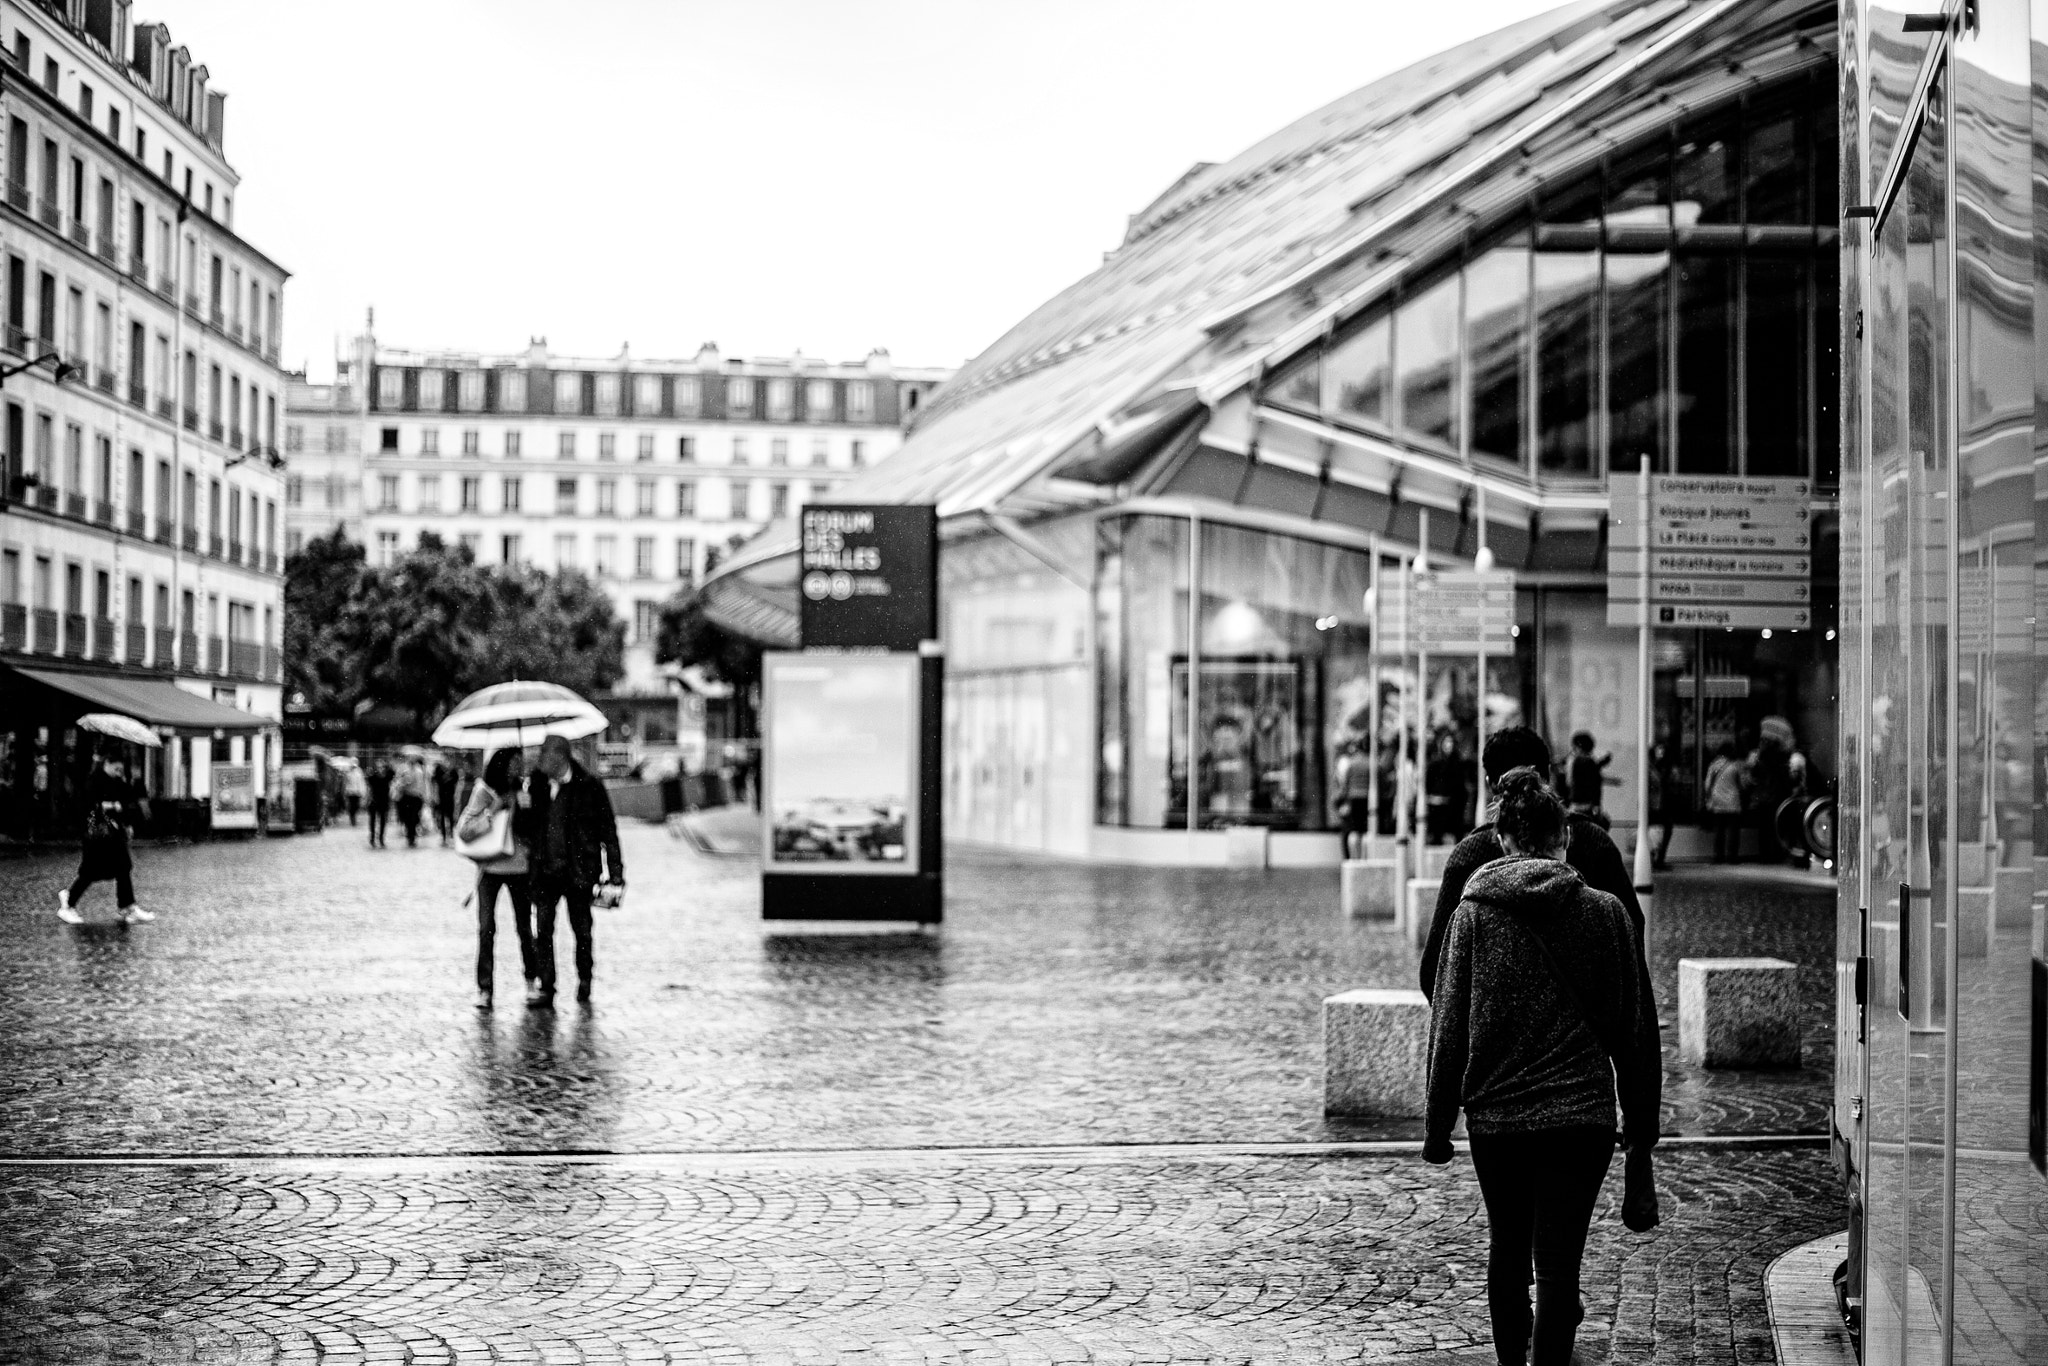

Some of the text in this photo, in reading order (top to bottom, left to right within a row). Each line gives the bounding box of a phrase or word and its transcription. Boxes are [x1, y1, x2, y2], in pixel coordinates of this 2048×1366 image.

[1659, 479, 1745, 494] Conservatoire
[804, 511, 874, 533] FORUM
[804, 529, 845, 551] DES
[1659, 531, 1673, 544] La
[1676, 531, 1709, 545] Place
[804, 547, 881, 570] HALLES
[1677, 608, 1731, 623] Parkings
